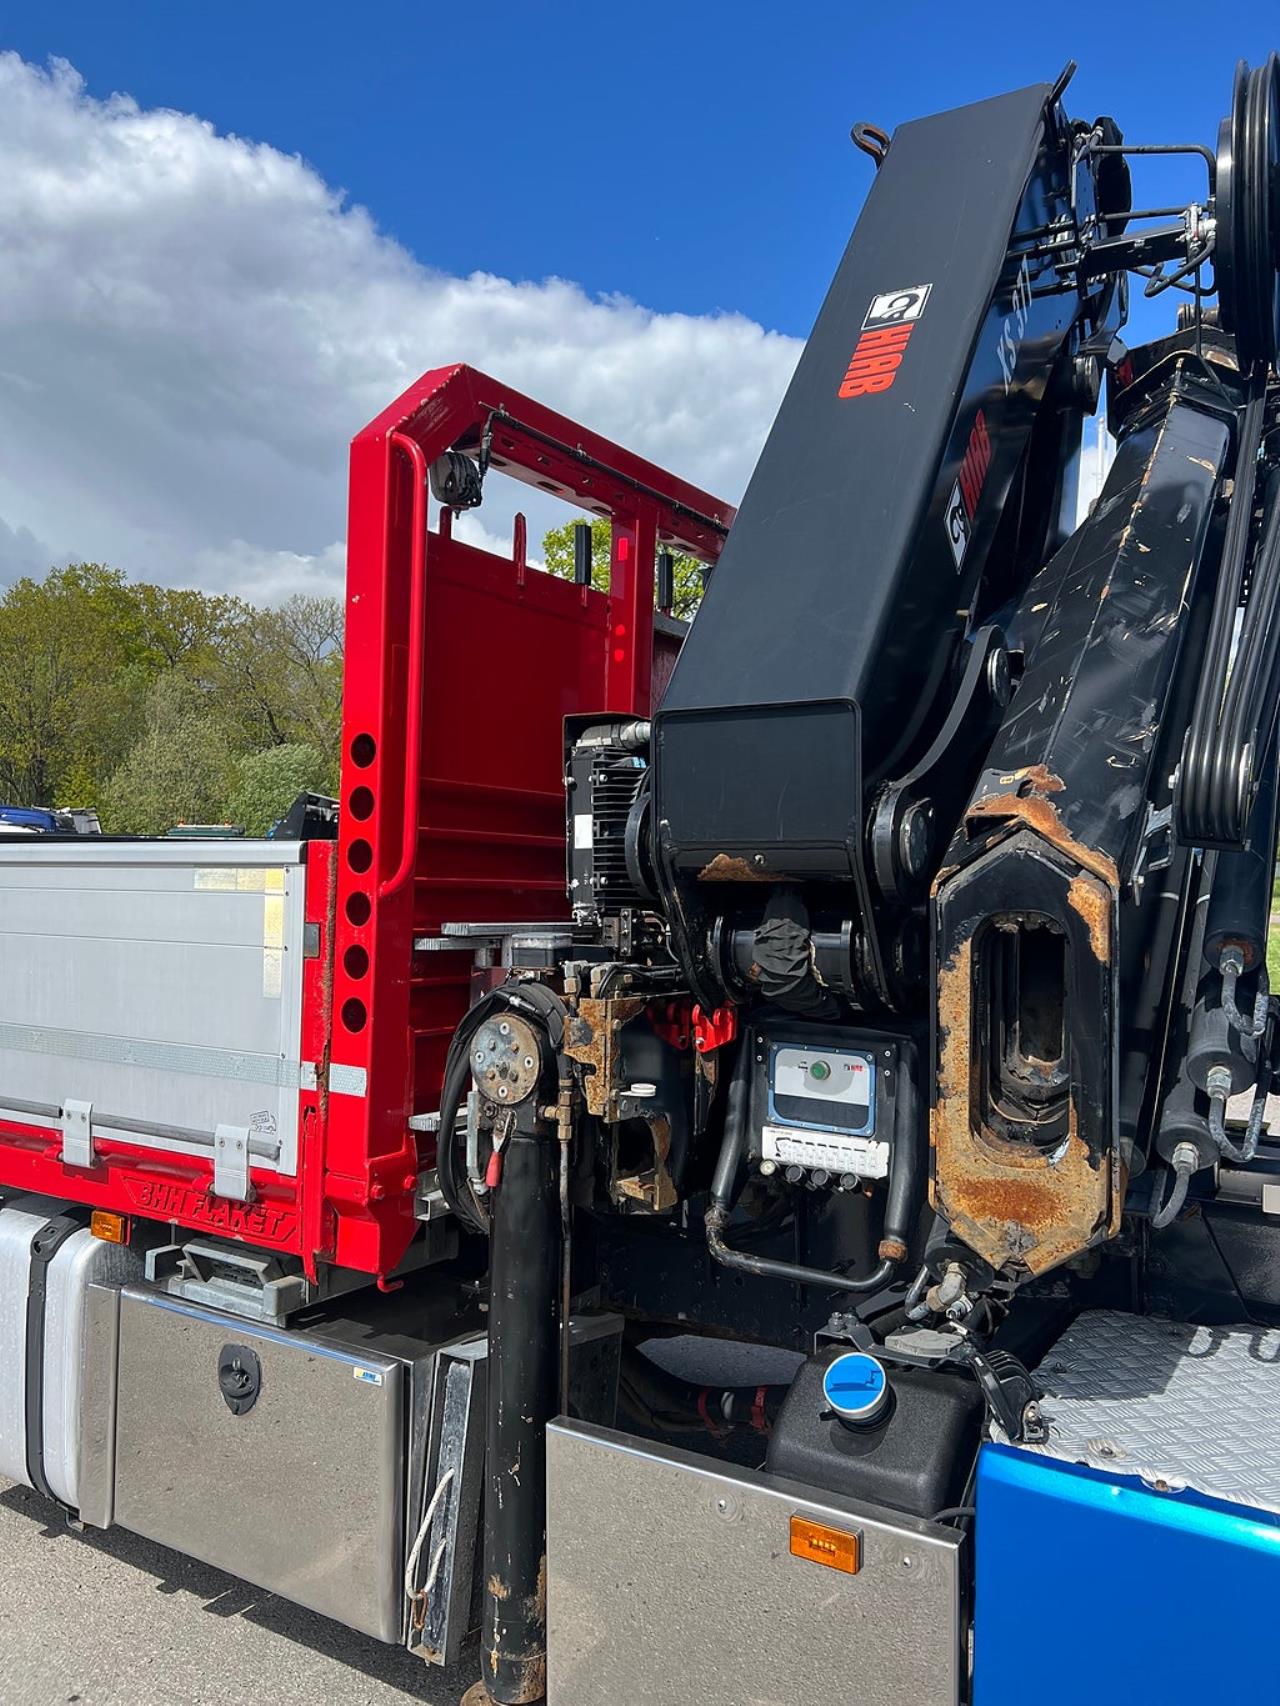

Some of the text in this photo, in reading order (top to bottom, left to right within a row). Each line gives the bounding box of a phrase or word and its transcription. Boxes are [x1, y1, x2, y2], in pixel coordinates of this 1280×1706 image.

[838, 323, 914, 398] HIAB
[997, 254, 1032, 396] XS 377
[959, 407, 991, 521] HIAB
[189, 1190, 286, 1239] FLAKET
